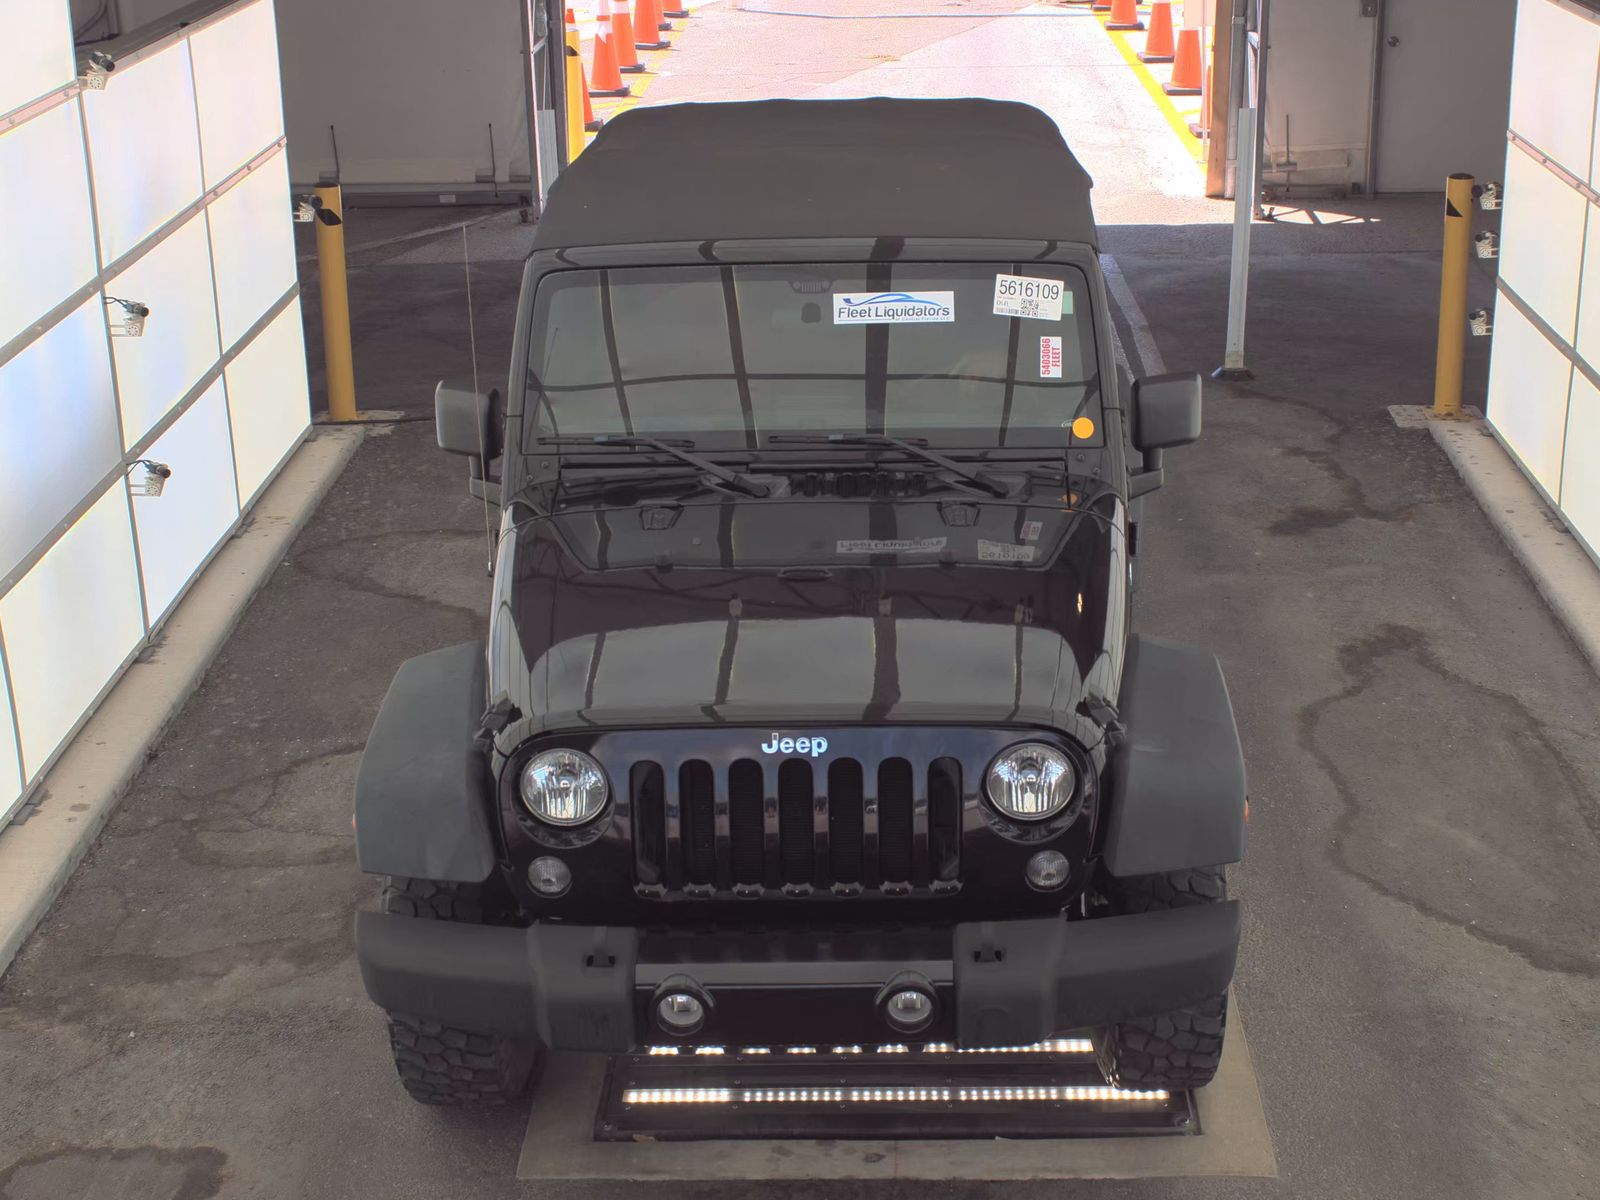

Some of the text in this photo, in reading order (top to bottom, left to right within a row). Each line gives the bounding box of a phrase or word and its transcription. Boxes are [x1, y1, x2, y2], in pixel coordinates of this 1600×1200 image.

[999, 279, 1060, 300] 5616109
[838, 304, 950, 320] Fleet Liquidators
[1041, 337, 1051, 375] 5403066
[1051, 347, 1060, 368] FLEET
[761, 732, 828, 757] Jeep
